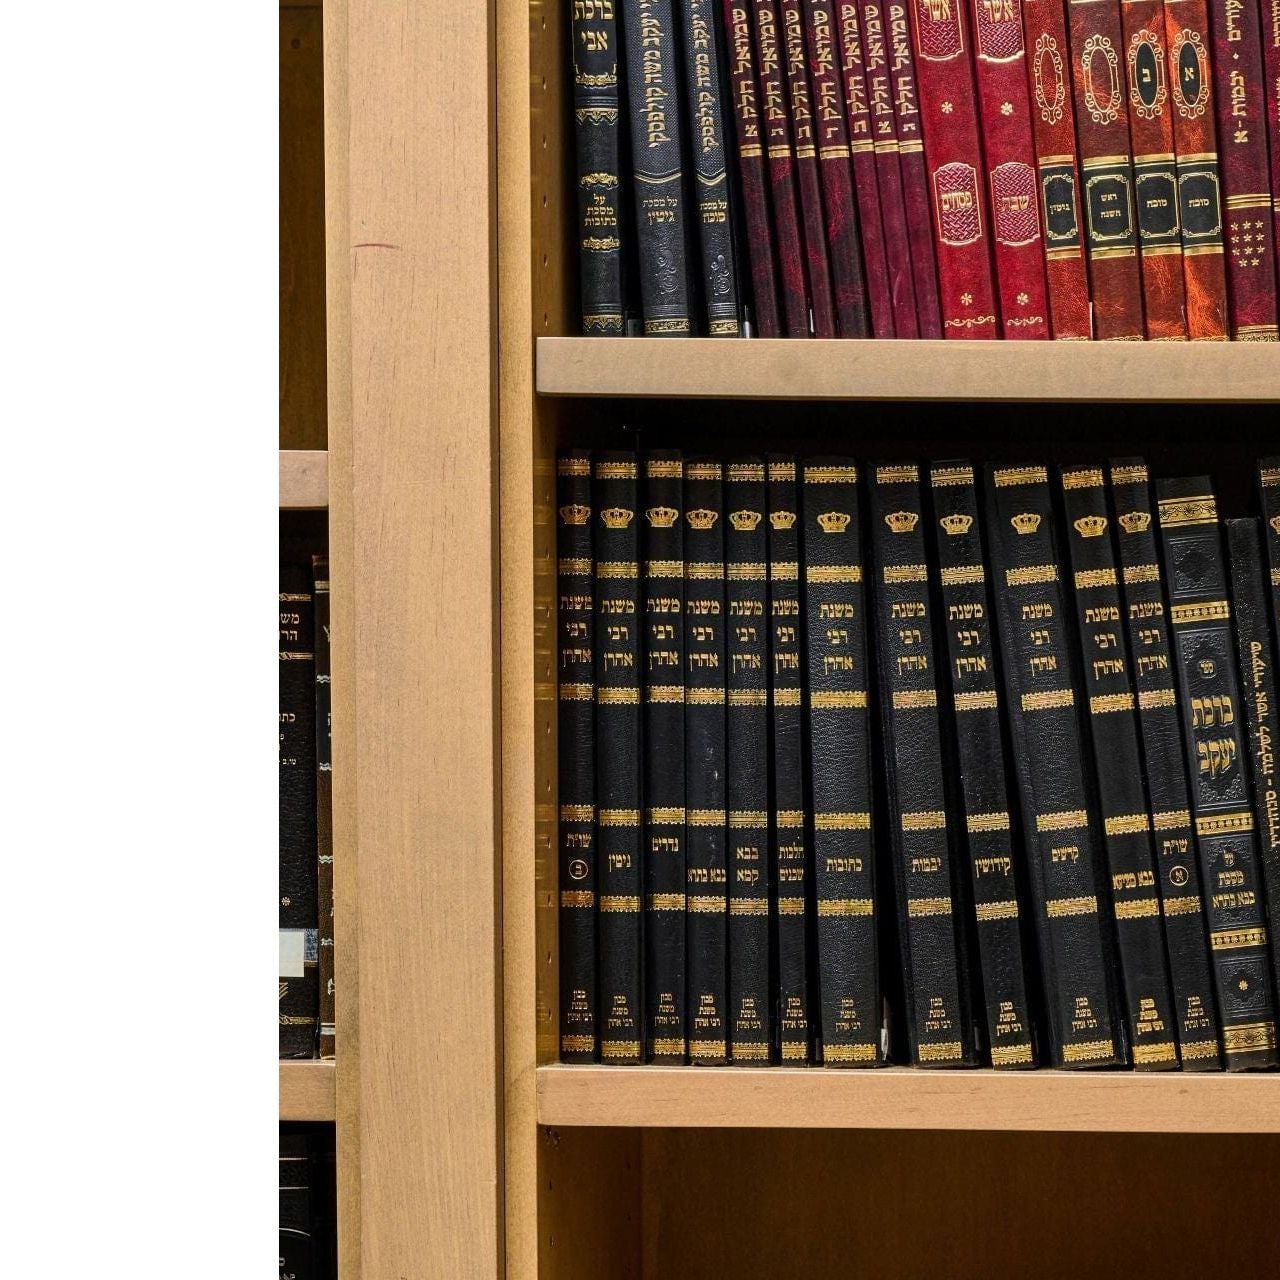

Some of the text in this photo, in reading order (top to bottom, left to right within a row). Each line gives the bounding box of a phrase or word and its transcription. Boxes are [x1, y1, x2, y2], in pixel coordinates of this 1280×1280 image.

[580, 31, 608, 51] אבי
[785, 10, 804, 75] שמואל
[841, 5, 861, 70] שמואל
[643, 50, 662, 83] משה
[733, 9, 758, 136] שמואל חלק א
[1142, 69, 1152, 82] ב
[1184, 68, 1195, 81] א
[793, 82, 811, 120] חלק
[847, 76, 869, 114] חלק
[1230, 71, 1248, 143] יבמות א
[587, 206, 614, 216] מסכת
[601, 600, 635, 614] משנת
[687, 600, 720, 614] משנת
[820, 603, 854, 618] משנת
[950, 604, 983, 620] משנת
[1086, 606, 1120, 623] משנת
[608, 626, 629, 640] רבי
[692, 626, 714, 641] רבי
[827, 630, 848, 644] רבי
[958, 630, 980, 646] רבי
[1095, 633, 1117, 648] רבי
[604, 652, 633, 672] אהרן
[689, 652, 718, 672] אהרן
[824, 656, 853, 676] אהרן
[956, 656, 986, 678] אהרן
[1094, 658, 1124, 680] אהרן
[1192, 694, 1234, 727] ברכת
[1198, 738, 1236, 778] יעקב
[736, 848, 759, 860] בבא
[826, 858, 862, 872] כתובות
[912, 858, 940, 872] יבמות
[974, 857, 1011, 878] קידושין
[736, 868, 758, 886] קמא
